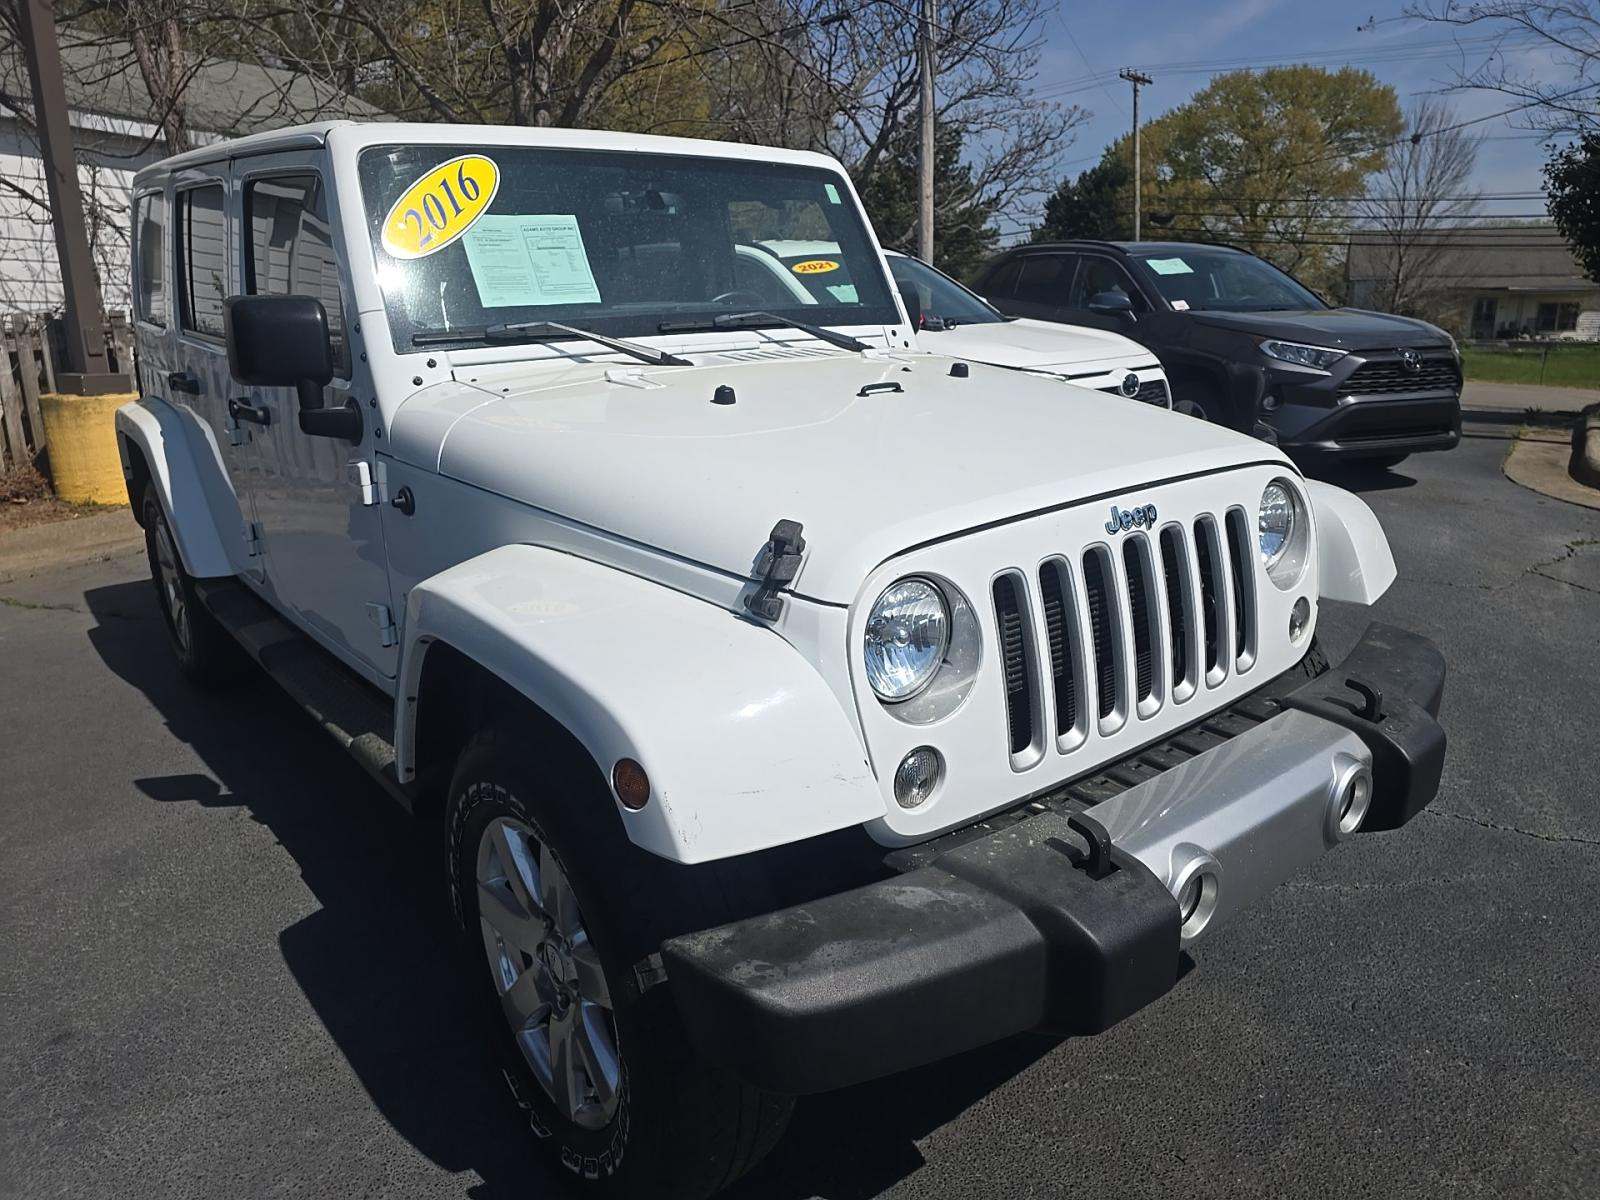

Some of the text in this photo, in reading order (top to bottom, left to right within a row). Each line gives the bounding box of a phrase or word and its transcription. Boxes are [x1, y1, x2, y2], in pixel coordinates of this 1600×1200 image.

[404, 162, 480, 247] 2016
[798, 262, 833, 272] 2021
[1105, 504, 1157, 535] Jeep
